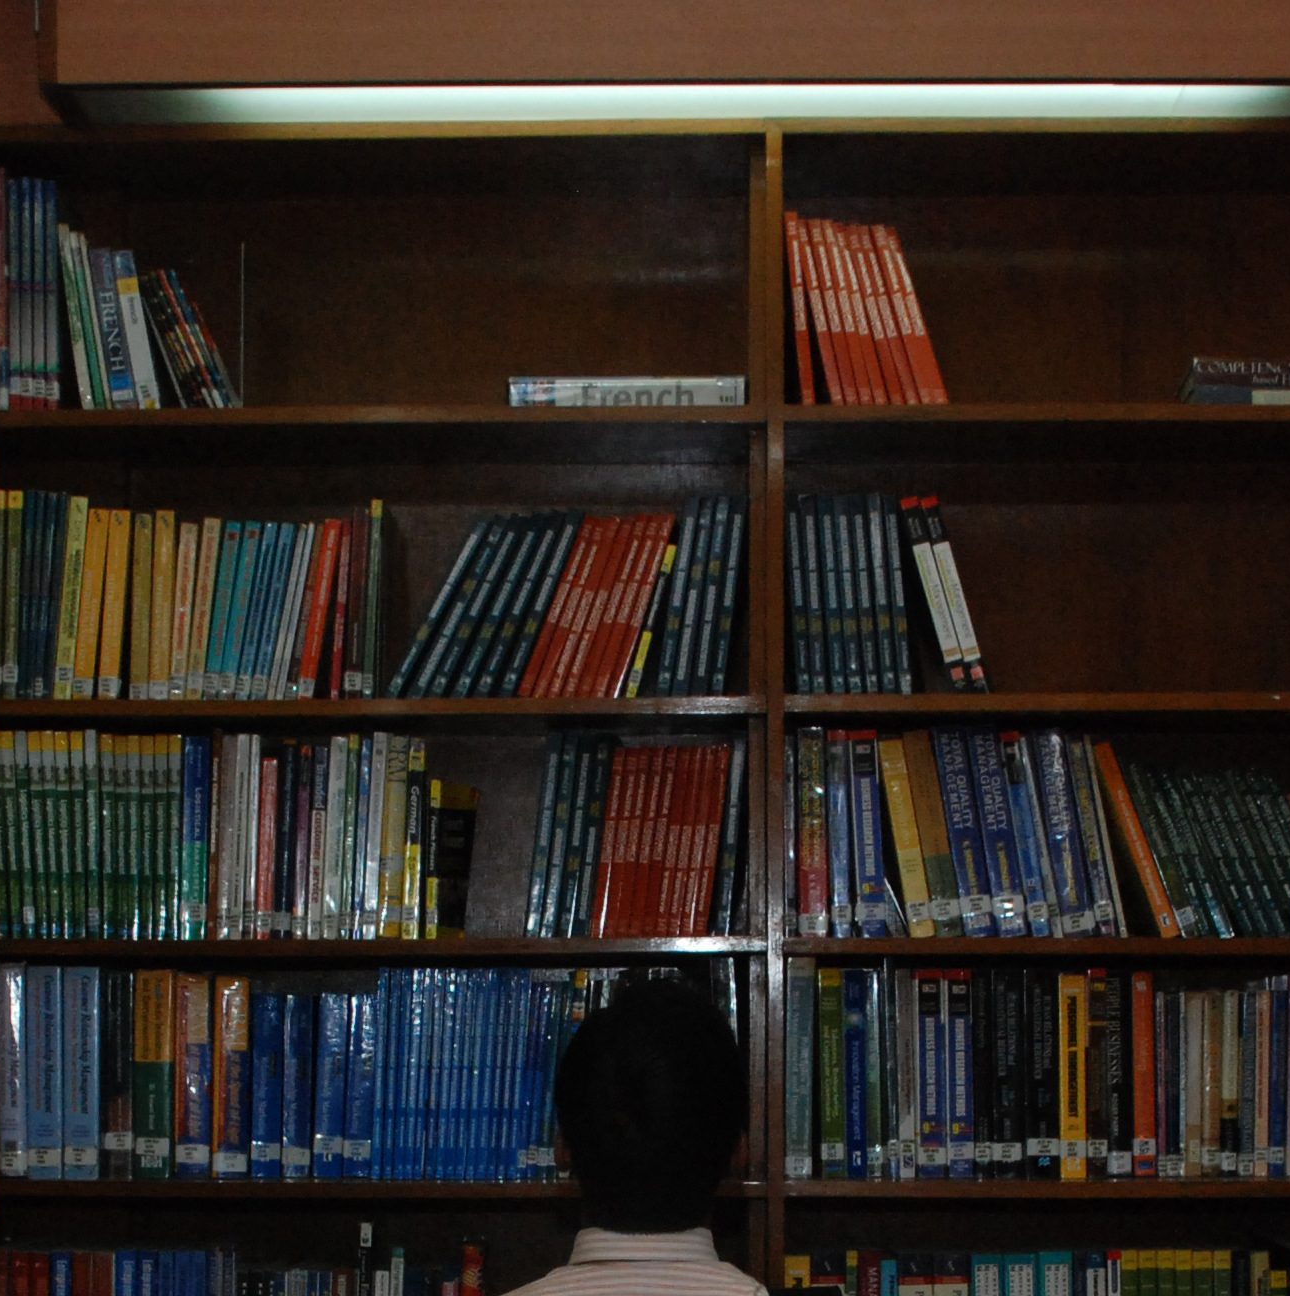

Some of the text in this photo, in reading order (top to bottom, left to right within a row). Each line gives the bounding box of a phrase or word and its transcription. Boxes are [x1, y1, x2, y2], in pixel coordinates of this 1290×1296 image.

[99, 292, 126, 372] FRENCH
[581, 380, 695, 407] French
[407, 786, 421, 835] German
[941, 733, 965, 829] MANAGEMENT
[948, 732, 973, 829] TOTAL QUALITY
[976, 735, 995, 831] MANAGEMENT
[982, 734, 1008, 829] TOTAL QUALITY
[192, 786, 205, 902] LOGISTICAL MANAGEMENT
[310, 763, 325, 904] branded customer service
[850, 1041, 862, 1141] Innovation Management
[1067, 995, 1079, 1119] PERSONNEL MANAGEMENT
